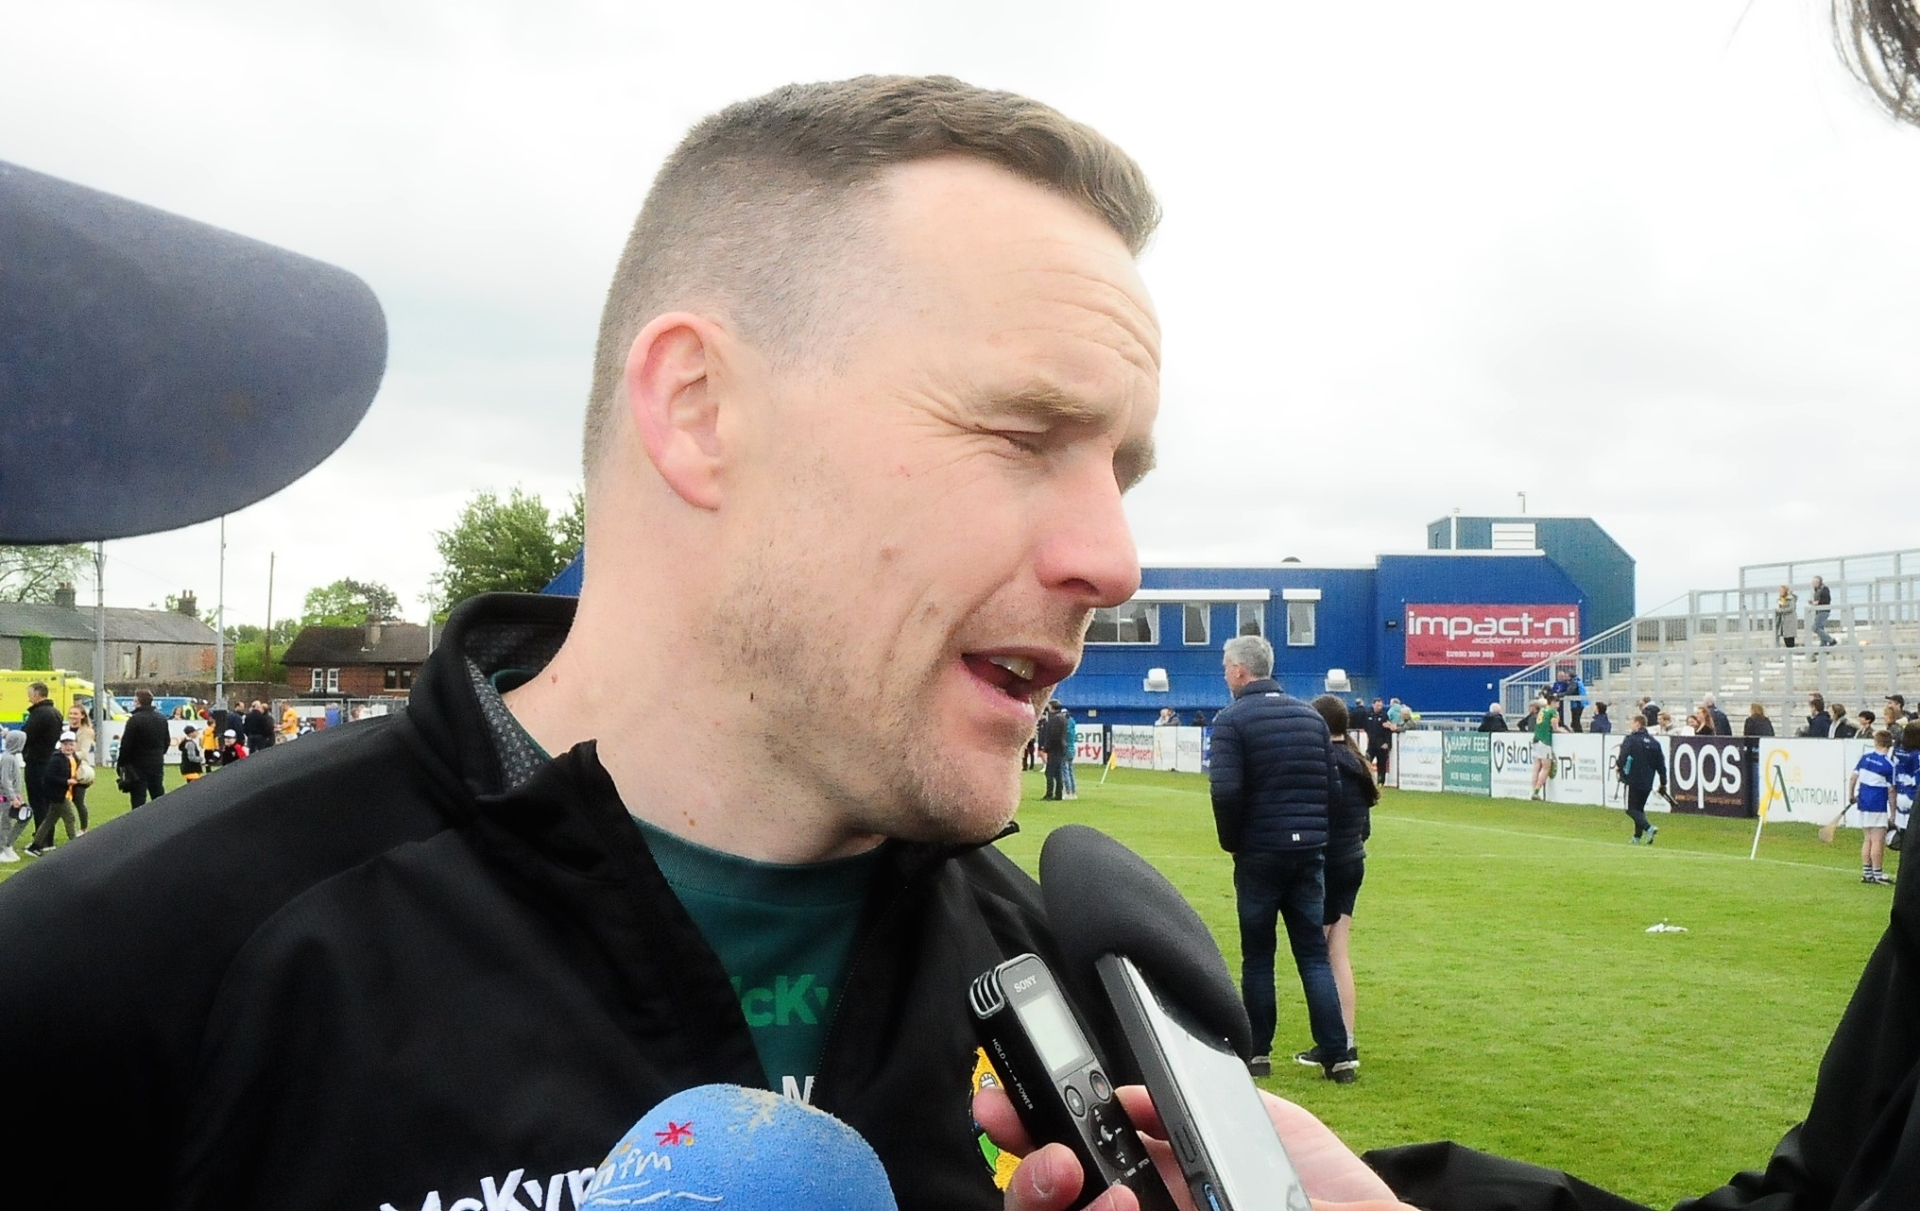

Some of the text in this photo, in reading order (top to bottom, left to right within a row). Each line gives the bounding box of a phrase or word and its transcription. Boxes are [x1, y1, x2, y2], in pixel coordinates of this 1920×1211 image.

[1408, 611, 1576, 640] impact-ni
[1472, 636, 1576, 645] accident management
[1075, 732, 1102, 743] ern
[1451, 736, 1471, 751] HAPPY
[1473, 736, 1490, 753] FEET
[1077, 744, 1102, 760] rty
[1506, 741, 1533, 765] strat
[1674, 743, 1742, 809] ops
[1014, 975, 1037, 993] SONY
[730, 974, 829, 1028] cK
[992, 1038, 1006, 1060] HOLD
[1016, 1082, 1034, 1111] POWER
